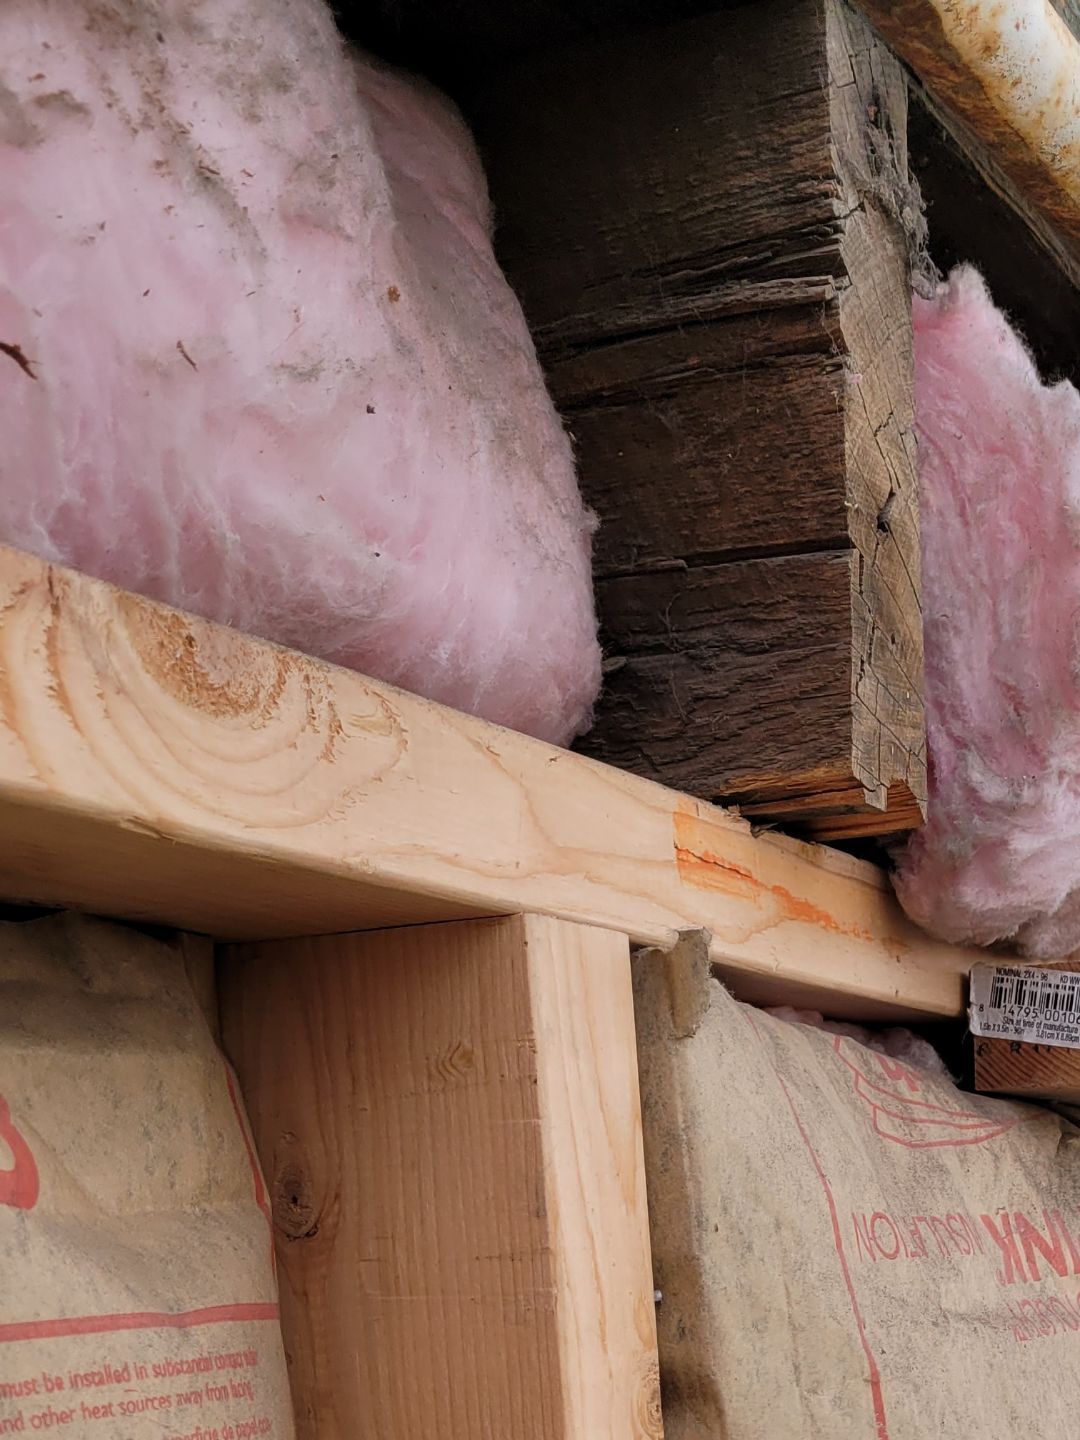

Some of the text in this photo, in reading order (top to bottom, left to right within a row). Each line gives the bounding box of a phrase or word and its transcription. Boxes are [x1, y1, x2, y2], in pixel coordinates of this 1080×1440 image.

[995, 967, 1021, 977] NOMINAL
[1023, 970, 1035, 979] 2X4
[1040, 972, 1049, 981] 96
[978, 1003, 985, 1012] 8
[1002, 1004, 1038, 1019] 14795
[1043, 1022, 1079, 1033] manufacture
[0, 1378, 40, 1398] must
[42, 1371, 65, 1393] be
[68, 1361, 131, 1389] installed
[133, 1361, 149, 1381] in
[0, 1409, 25, 1434] nd
[31, 1405, 76, 1429] other
[81, 1400, 116, 1421] heat
[117, 1394, 172, 1416] sources
[176, 1390, 203, 1408] away
[205, 1382, 229, 1401] from
